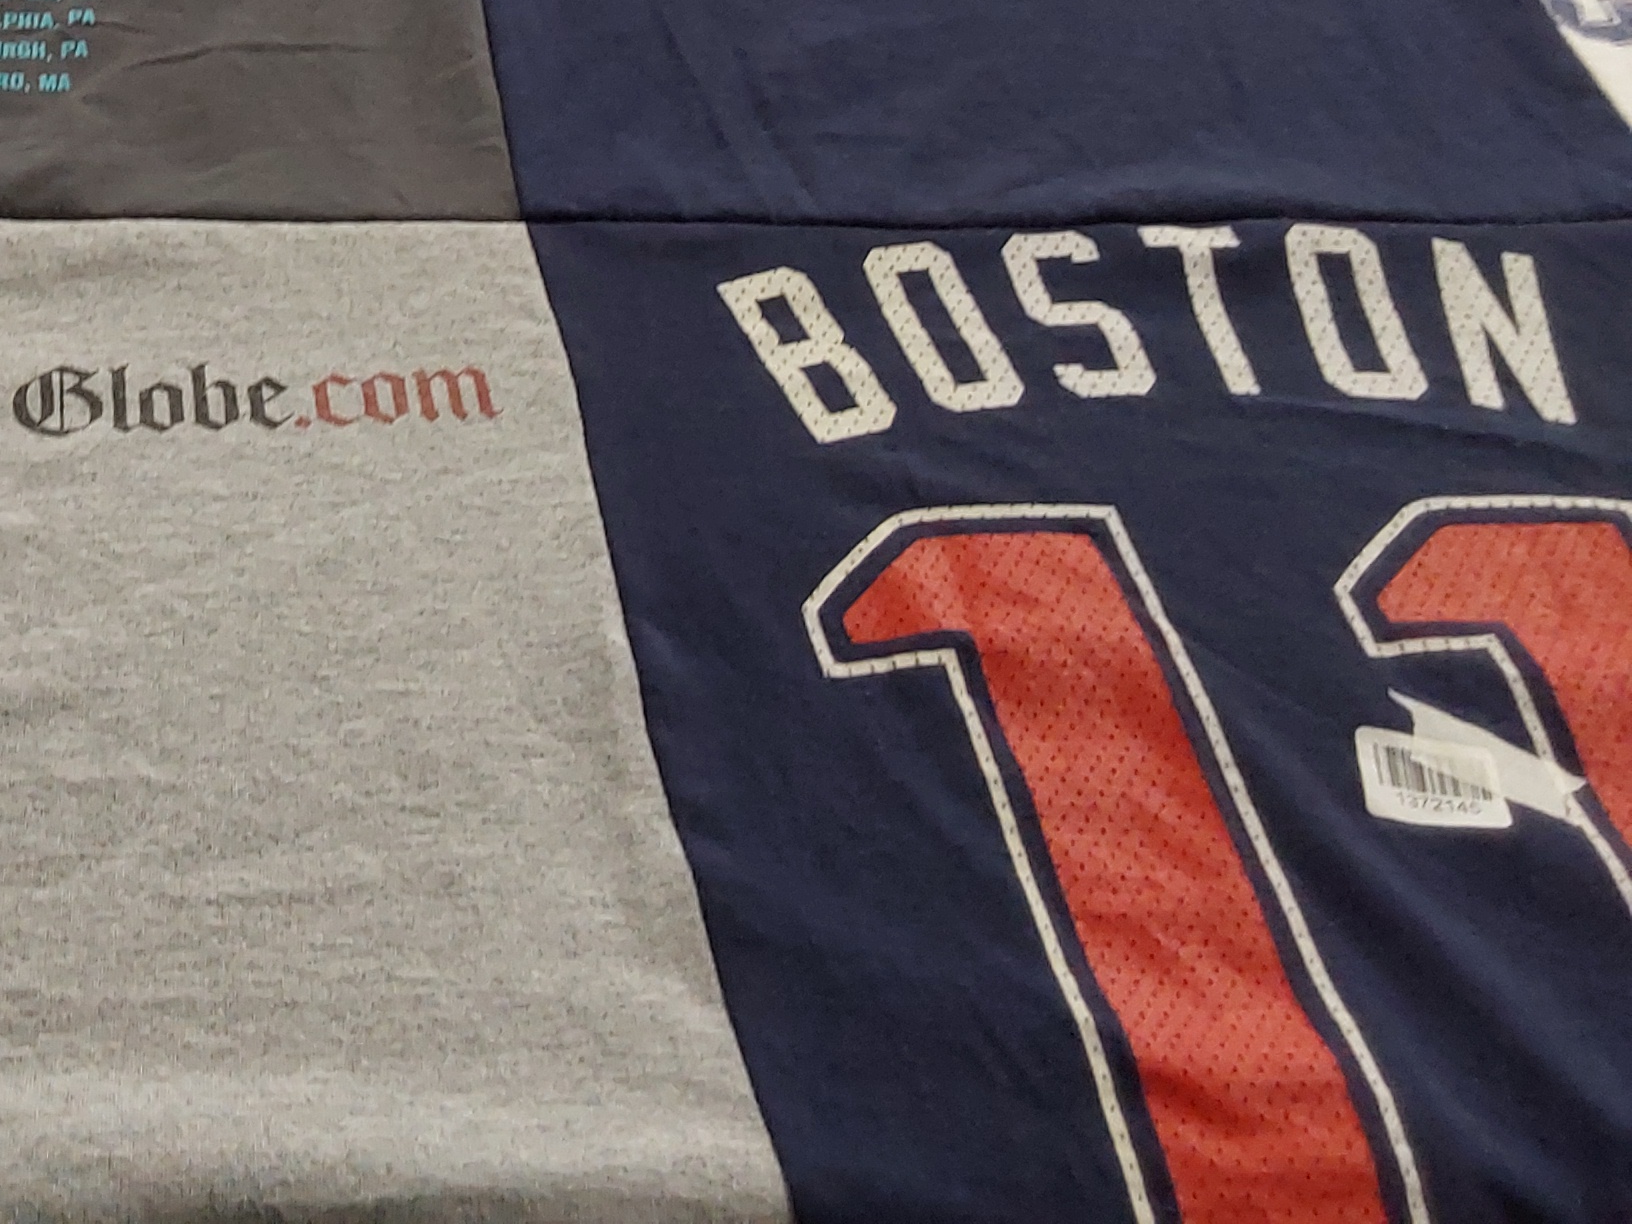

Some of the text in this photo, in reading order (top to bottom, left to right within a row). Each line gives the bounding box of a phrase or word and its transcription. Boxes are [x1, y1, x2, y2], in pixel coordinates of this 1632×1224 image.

[68, 9, 95, 25] PA
[60, 39, 88, 58] PA
[38, 72, 70, 92] MA
[717, 222, 1576, 445] BOSTON
[12, 362, 504, 437] Globe.com
